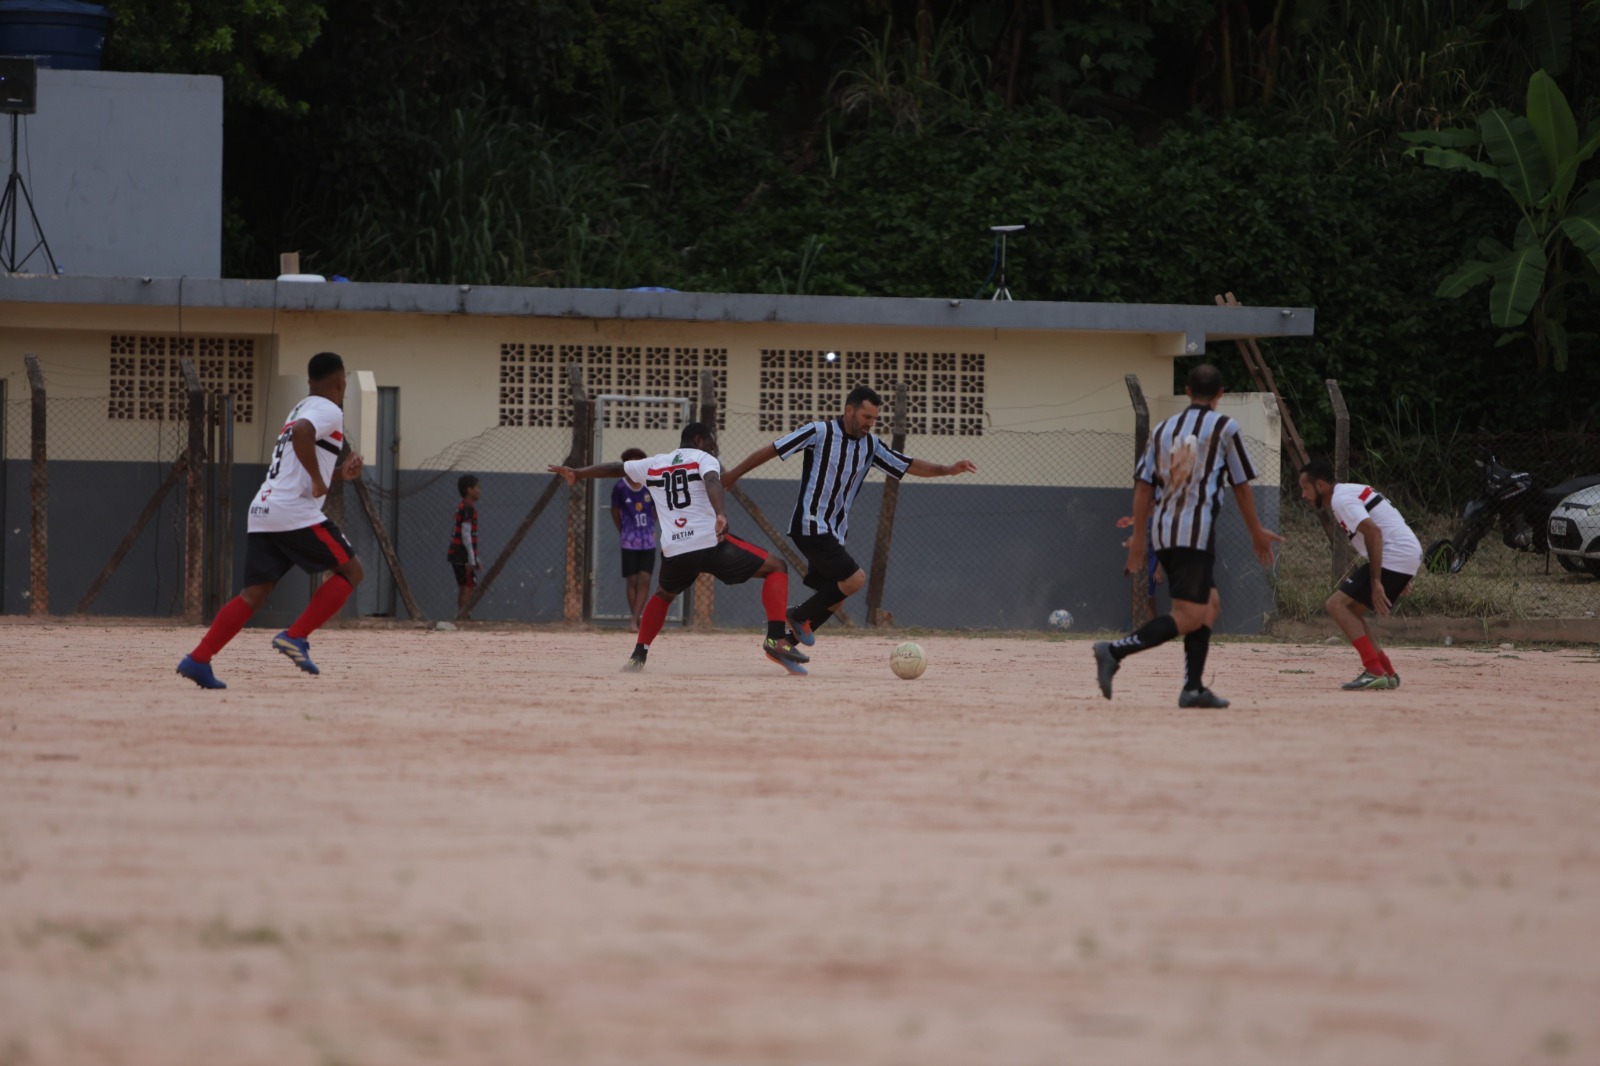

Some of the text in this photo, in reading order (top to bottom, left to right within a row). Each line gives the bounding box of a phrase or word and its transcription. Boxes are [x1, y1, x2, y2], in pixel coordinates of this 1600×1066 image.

[662, 468, 691, 511] 18
[634, 513, 648, 527] 10
[671, 530, 695, 541] BETIM
